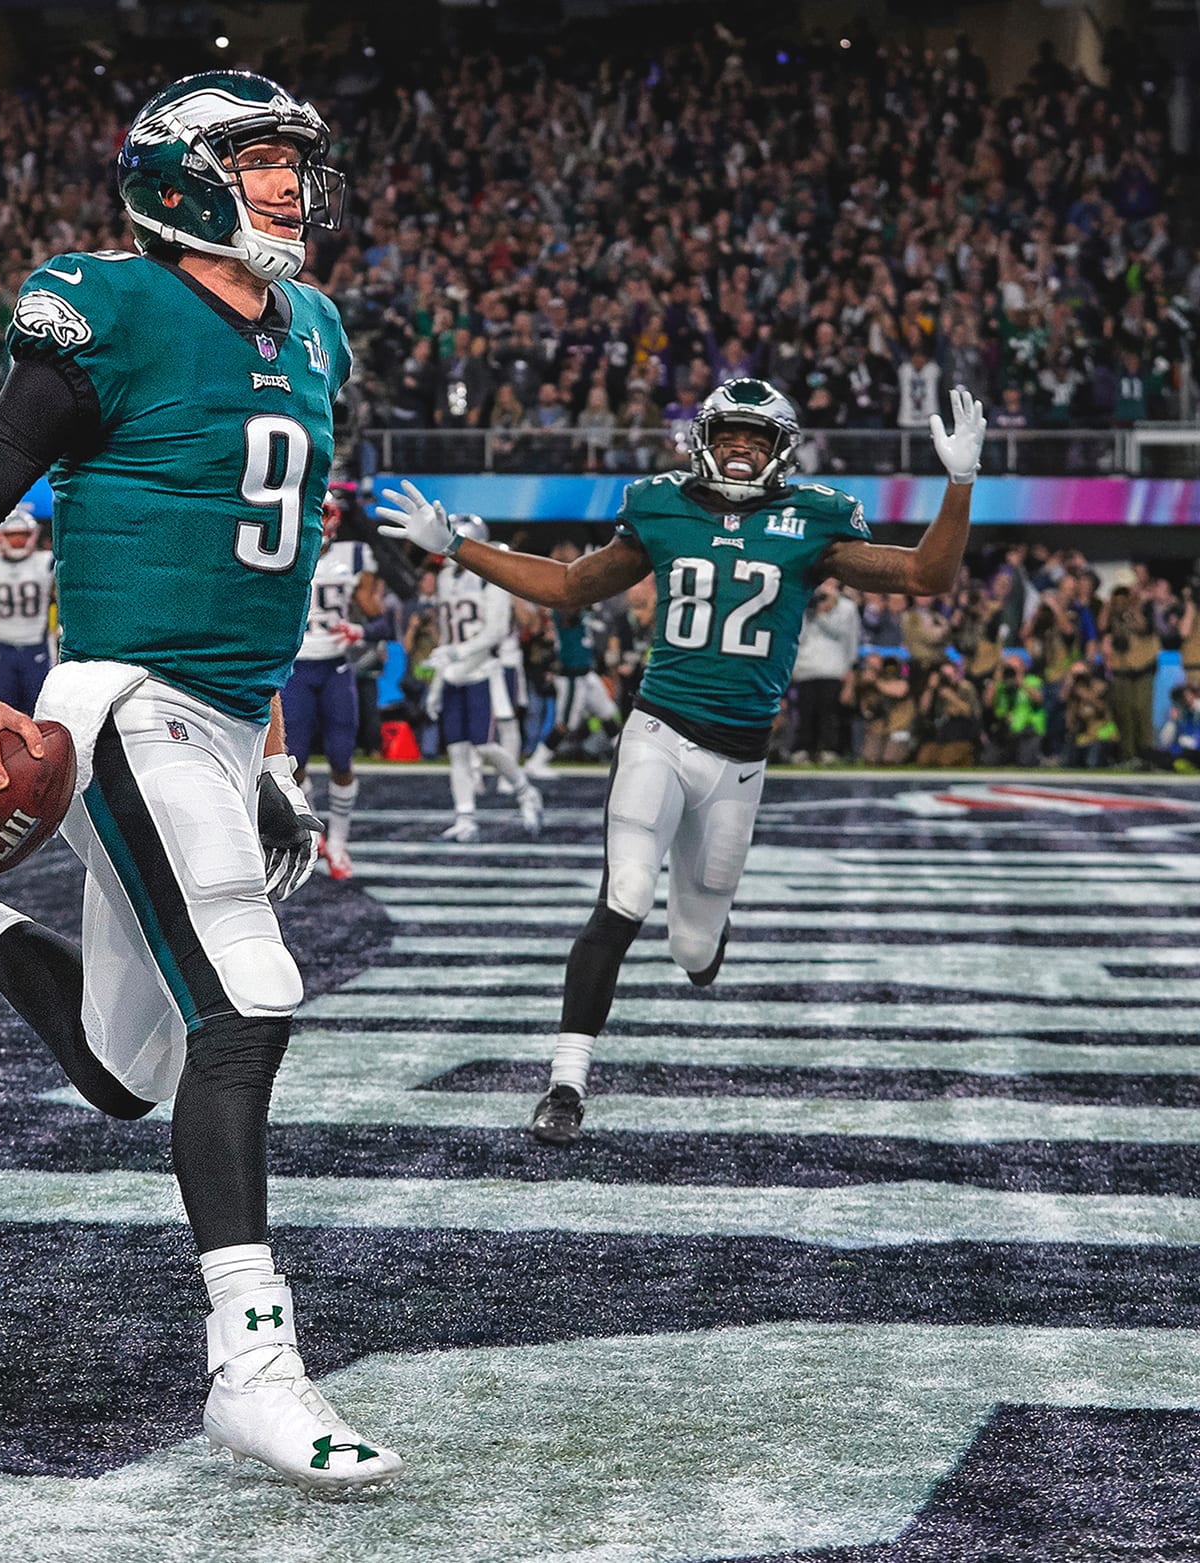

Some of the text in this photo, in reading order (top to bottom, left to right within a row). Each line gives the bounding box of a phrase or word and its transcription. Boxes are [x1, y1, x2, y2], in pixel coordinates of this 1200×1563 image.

[234, 412, 314, 575] 9
[765, 514, 806, 536] LII
[663, 555, 783, 659] 82
